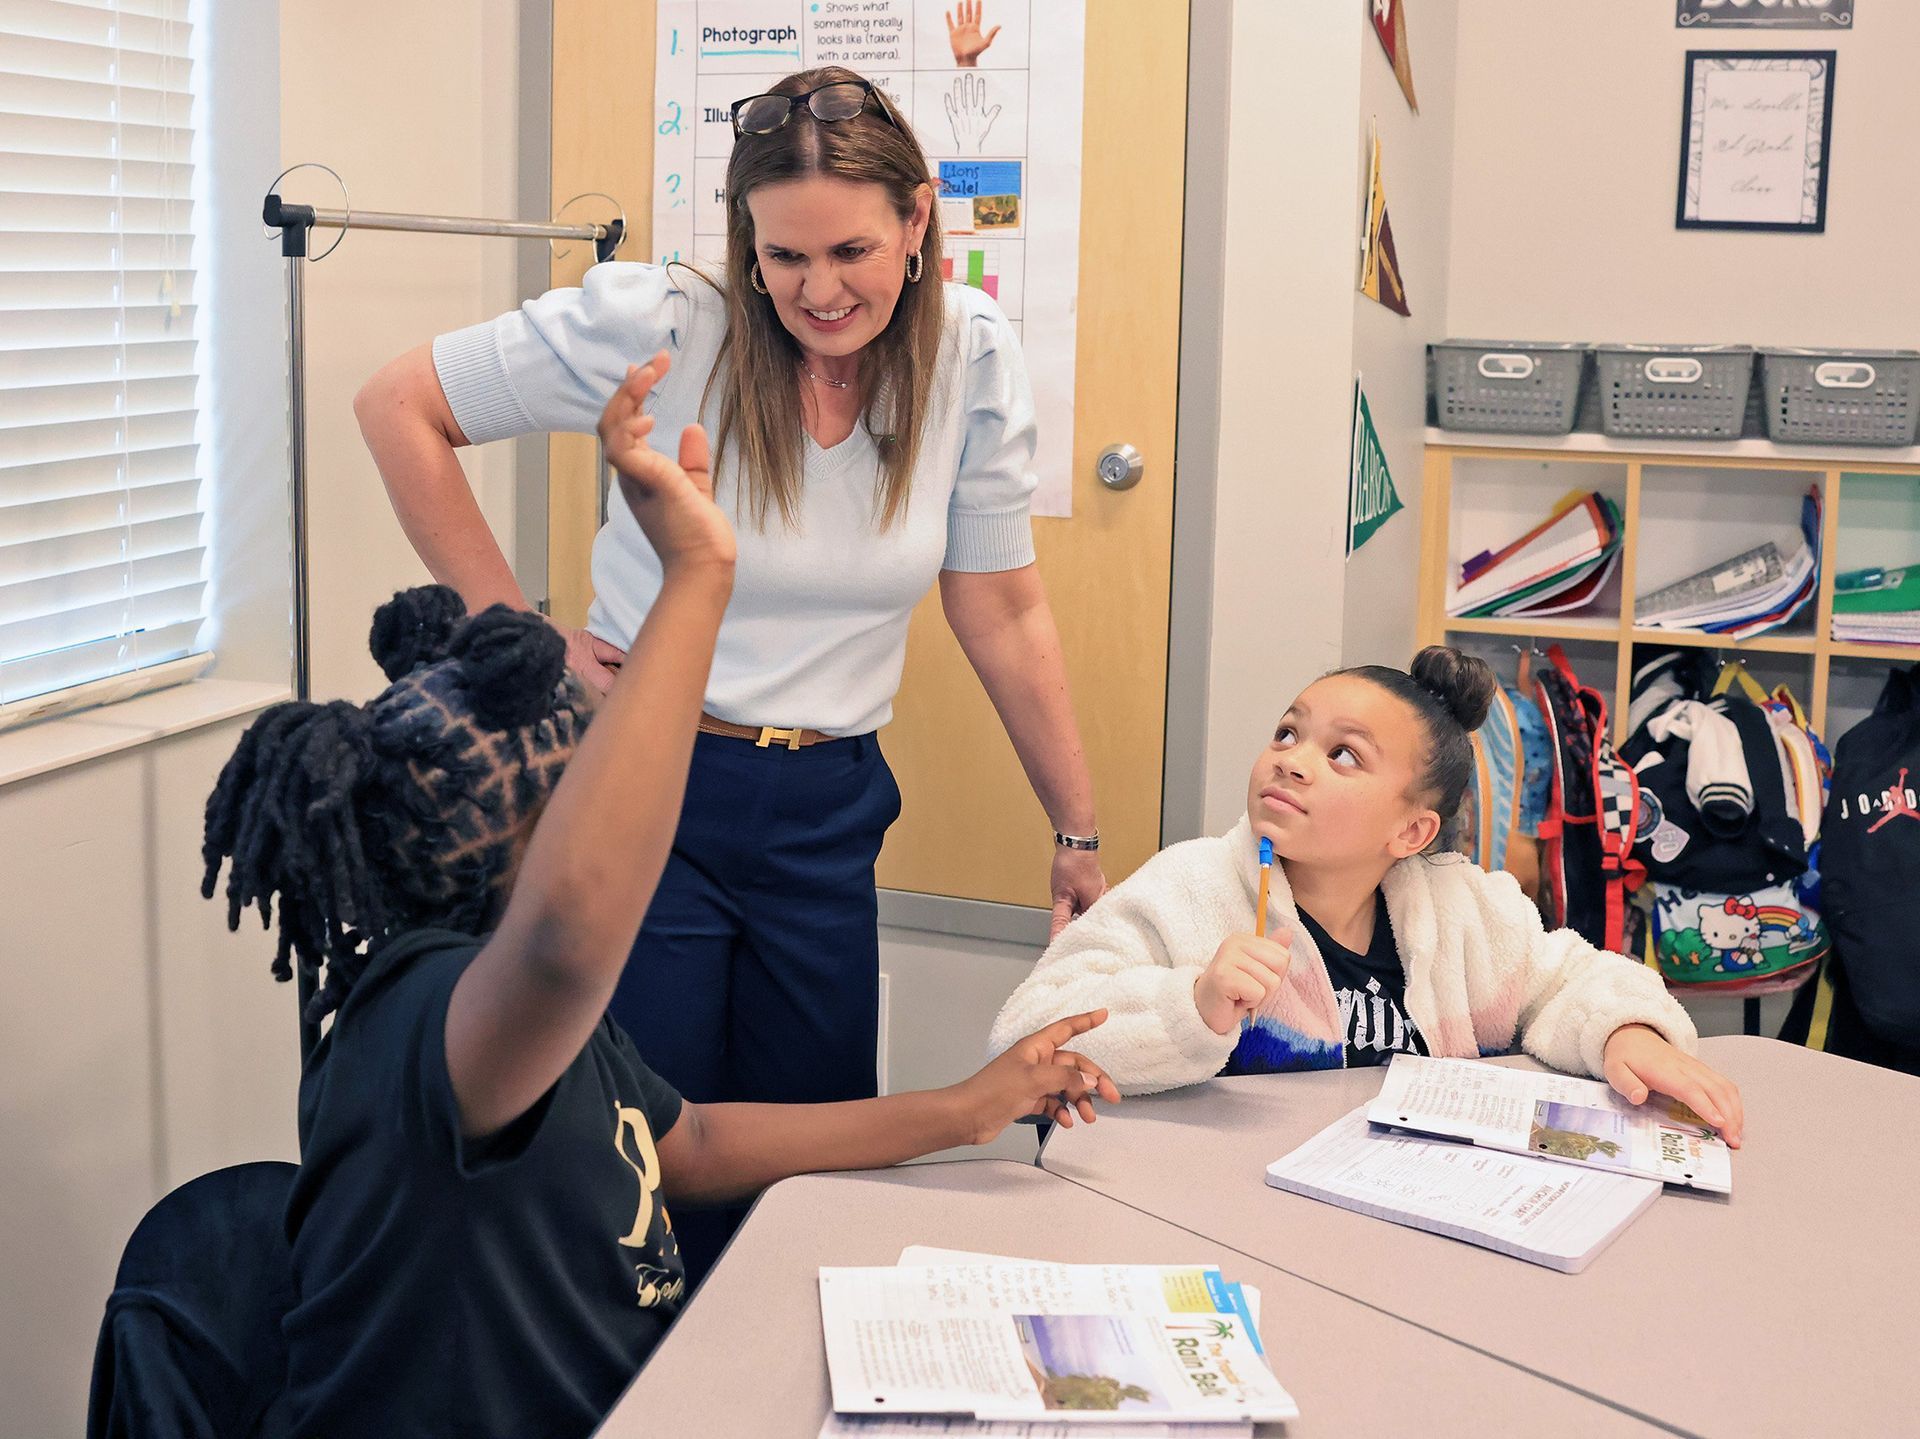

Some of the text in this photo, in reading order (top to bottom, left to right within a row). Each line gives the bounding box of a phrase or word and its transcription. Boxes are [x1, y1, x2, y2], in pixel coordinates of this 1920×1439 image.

[826, 1, 890, 13] Shows what
[813, 17, 903, 31] something really
[703, 26, 796, 44] Photograph
[817, 33, 899, 45] looks like (taken
[816, 51, 839, 61] with
[943, 164, 980, 179] Lions
[1172, 1337, 1207, 1368] Rain
